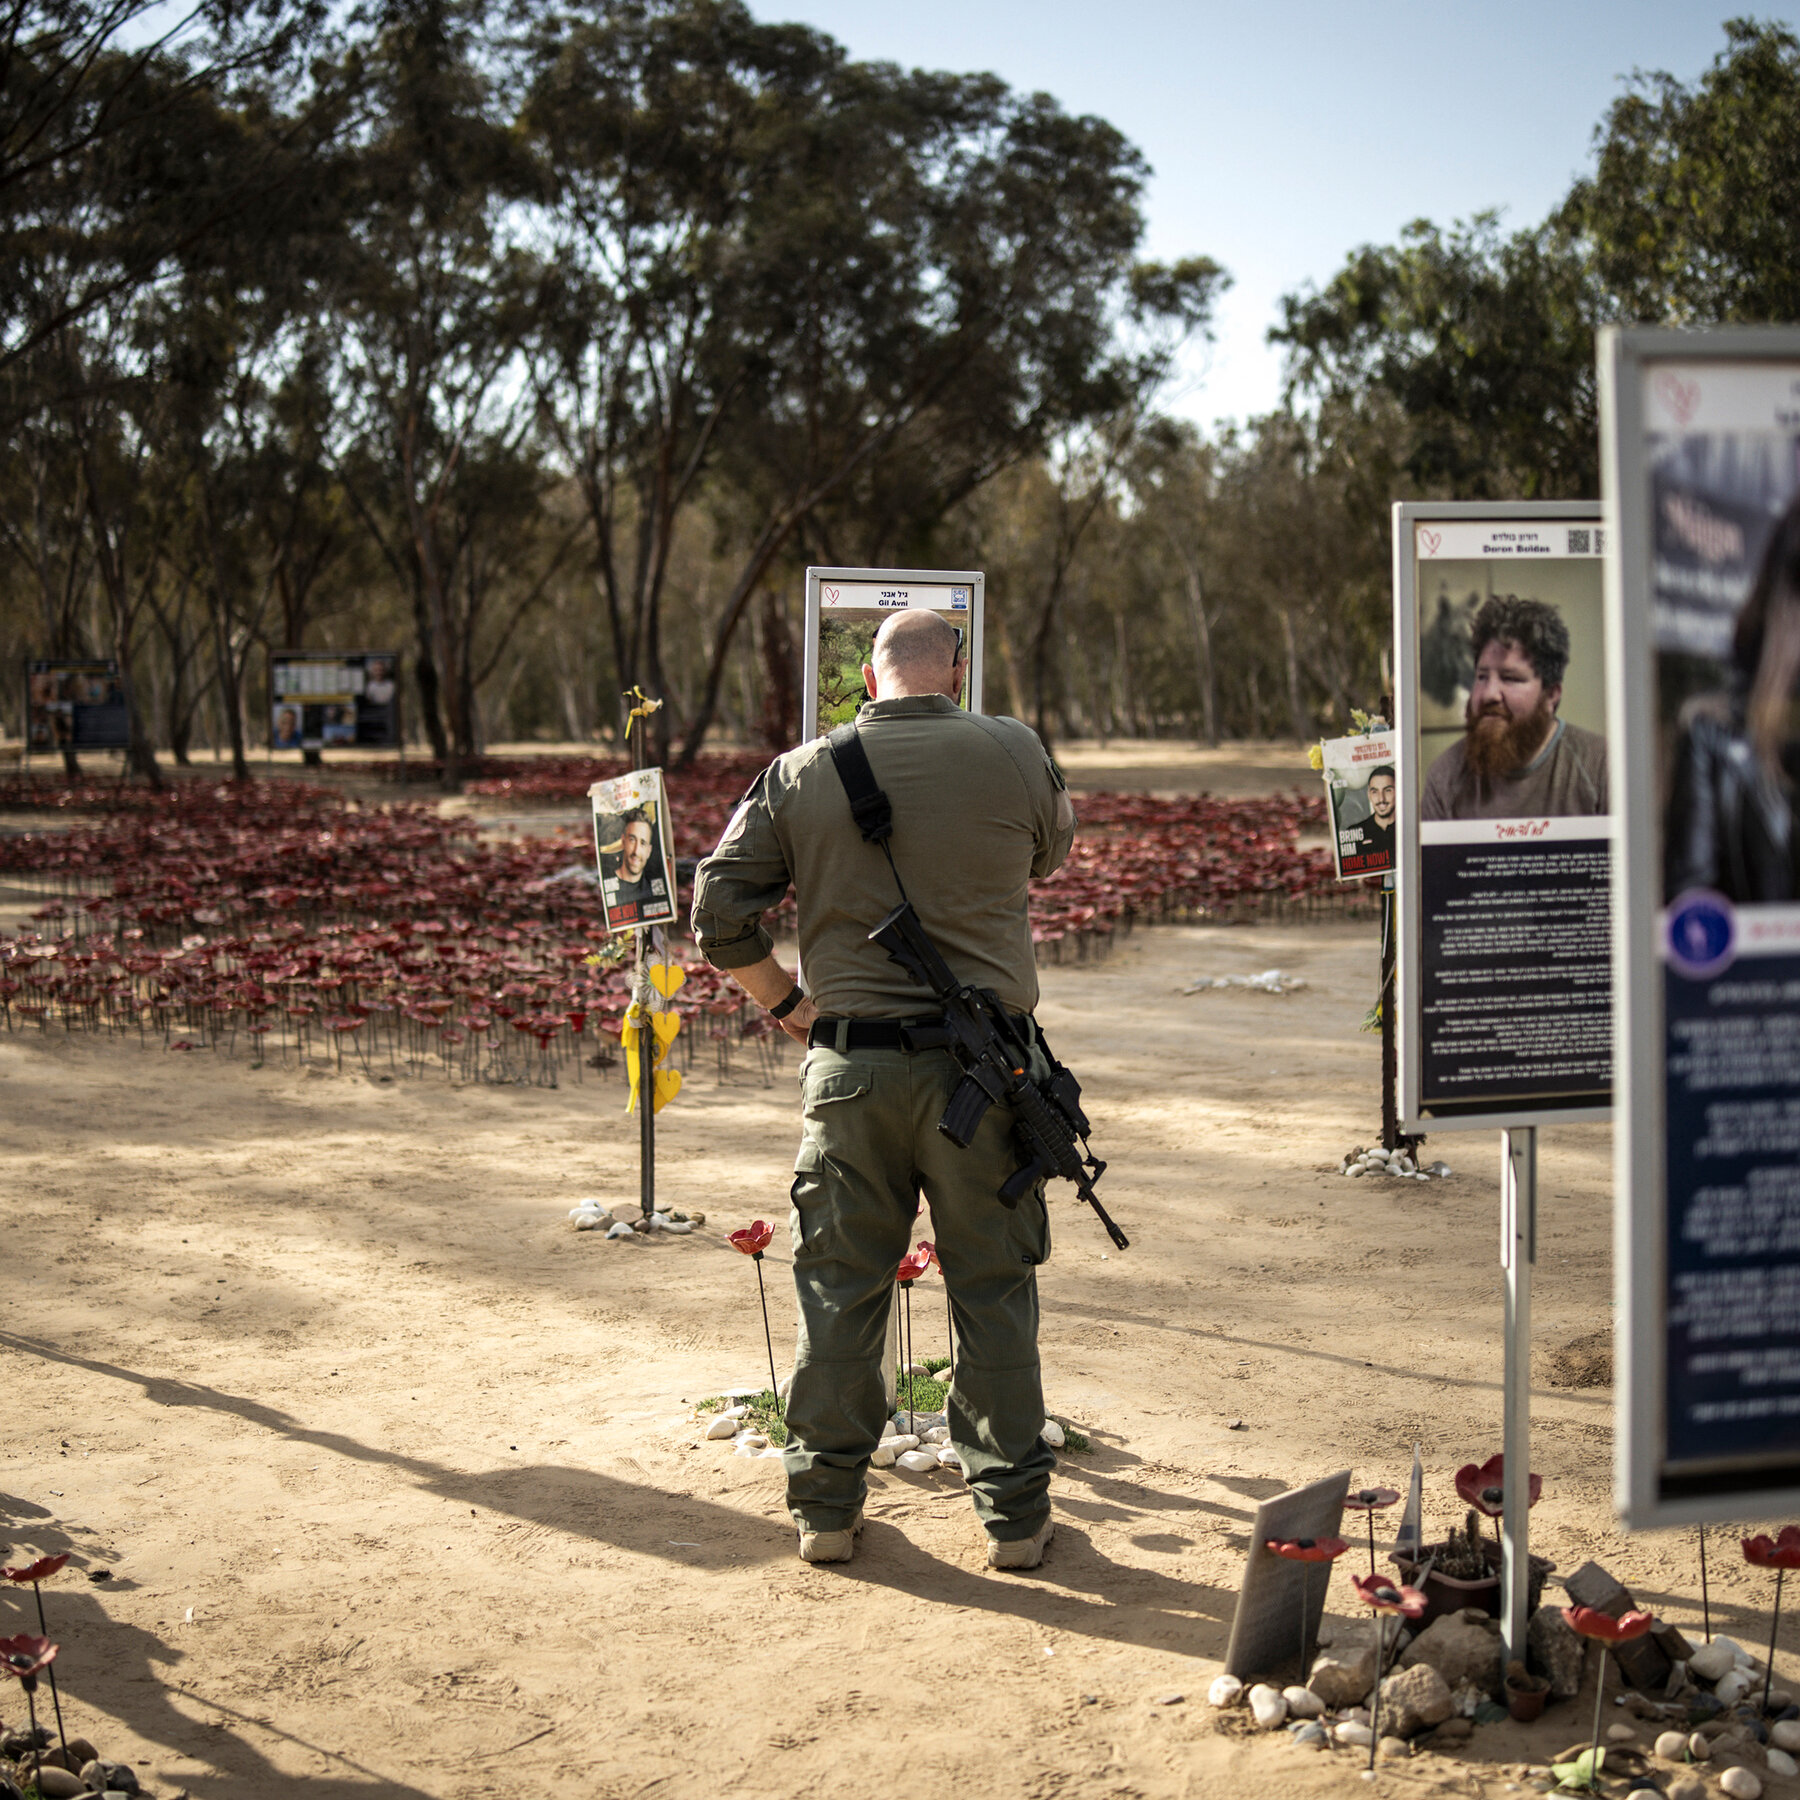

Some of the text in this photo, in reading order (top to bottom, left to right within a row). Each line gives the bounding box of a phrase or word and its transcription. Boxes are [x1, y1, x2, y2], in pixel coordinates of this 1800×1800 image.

[1483, 545, 1550, 553] Doron Boldas
[1339, 828, 1364, 843] BRING
[1340, 842, 1357, 856] HIM
[1342, 849, 1390, 870] HOME NOW!
